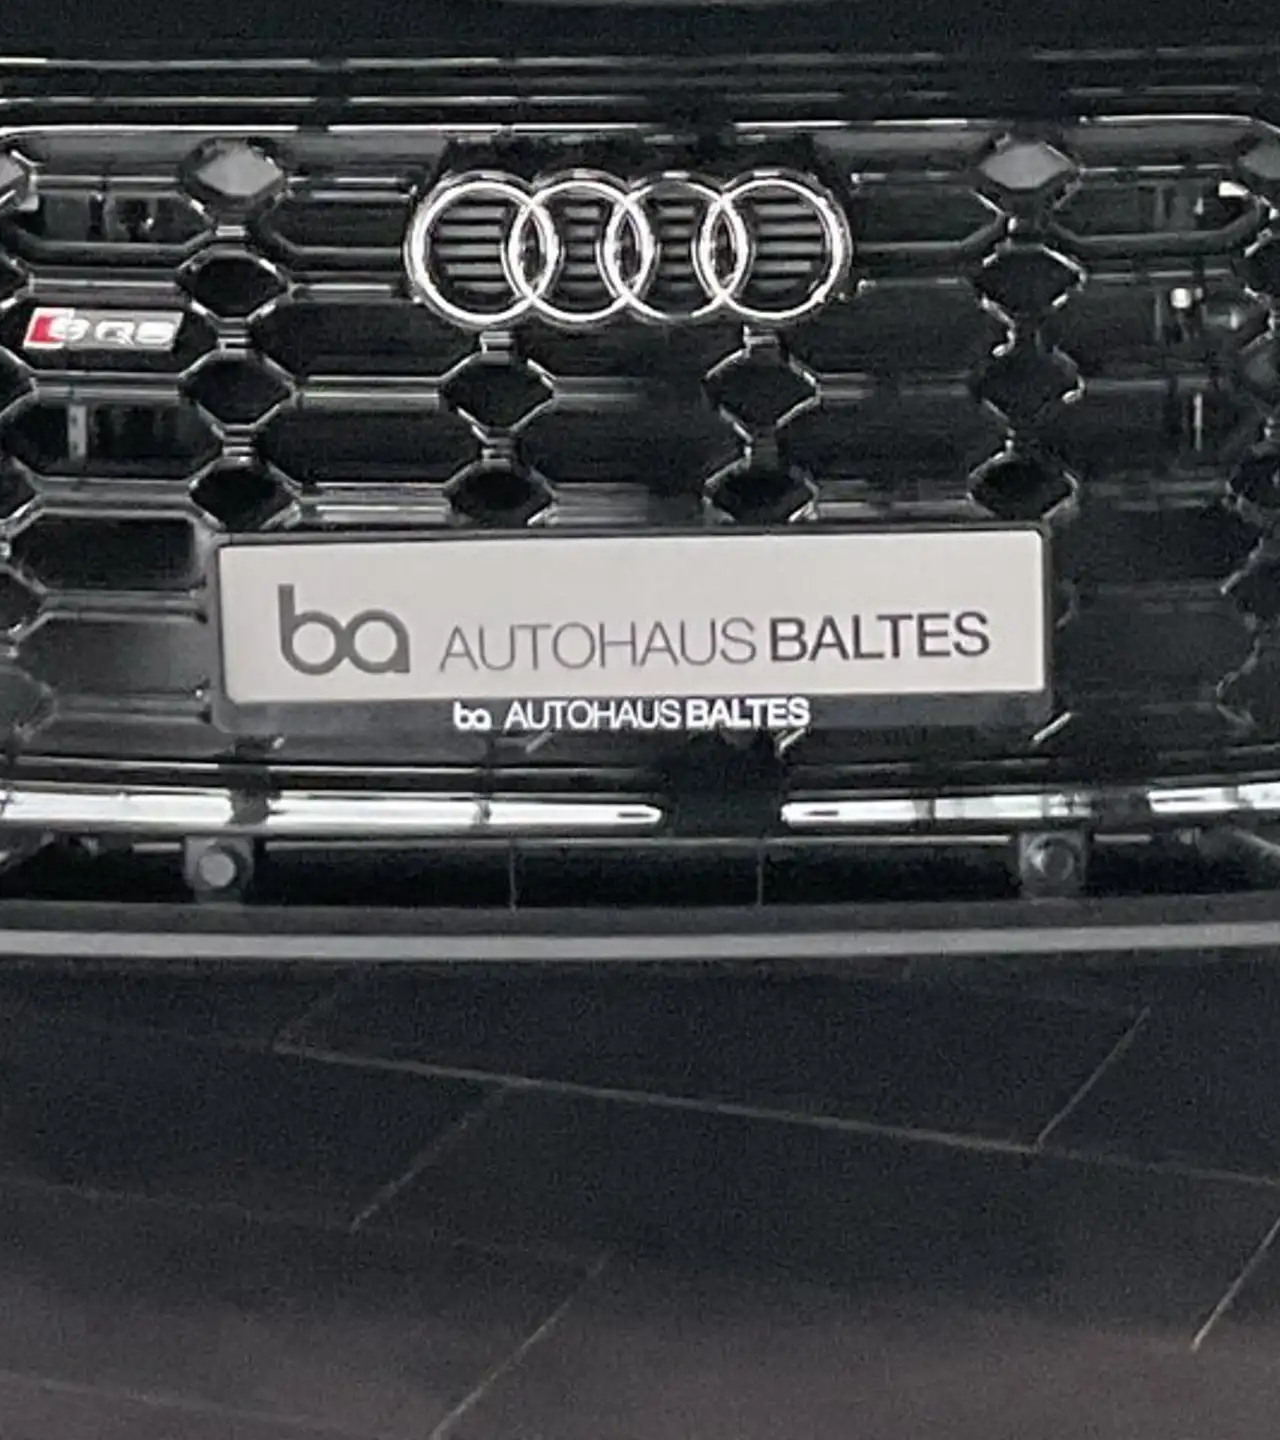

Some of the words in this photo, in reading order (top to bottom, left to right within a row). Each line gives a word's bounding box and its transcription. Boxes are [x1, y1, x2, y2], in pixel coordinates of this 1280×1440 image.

[278, 584, 410, 675] ba
[439, 617, 757, 672] AUTOHAUS
[770, 612, 989, 662] BALTES
[453, 701, 492, 729] ba
[504, 698, 681, 729] AUTOHAUS
[685, 696, 810, 728] BALTES
